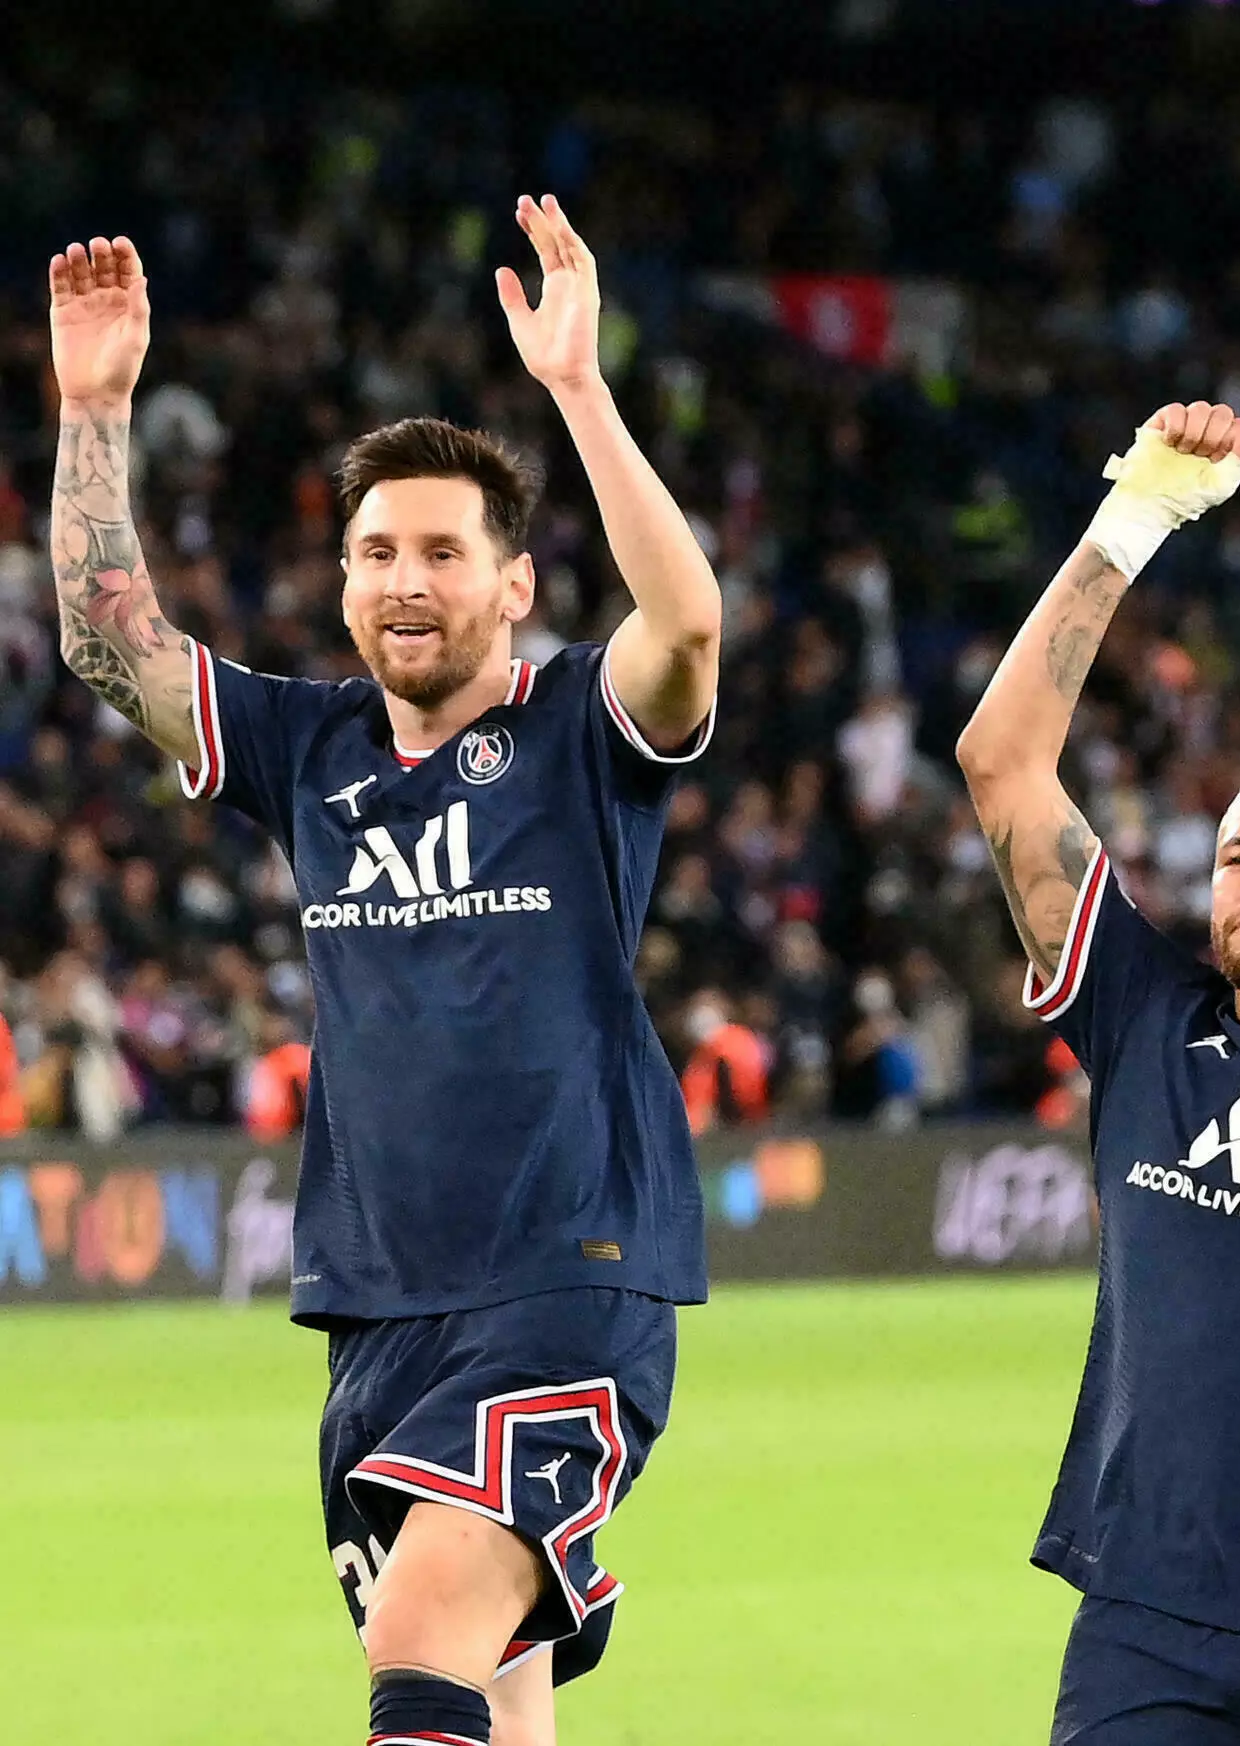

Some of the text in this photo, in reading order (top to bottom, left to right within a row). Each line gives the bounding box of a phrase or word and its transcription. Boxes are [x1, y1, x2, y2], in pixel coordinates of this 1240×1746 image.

[365, 901, 418, 927] LIVE
[419, 886, 552, 923] LIMITLESS
[1125, 1161, 1195, 1201] ACCOR
